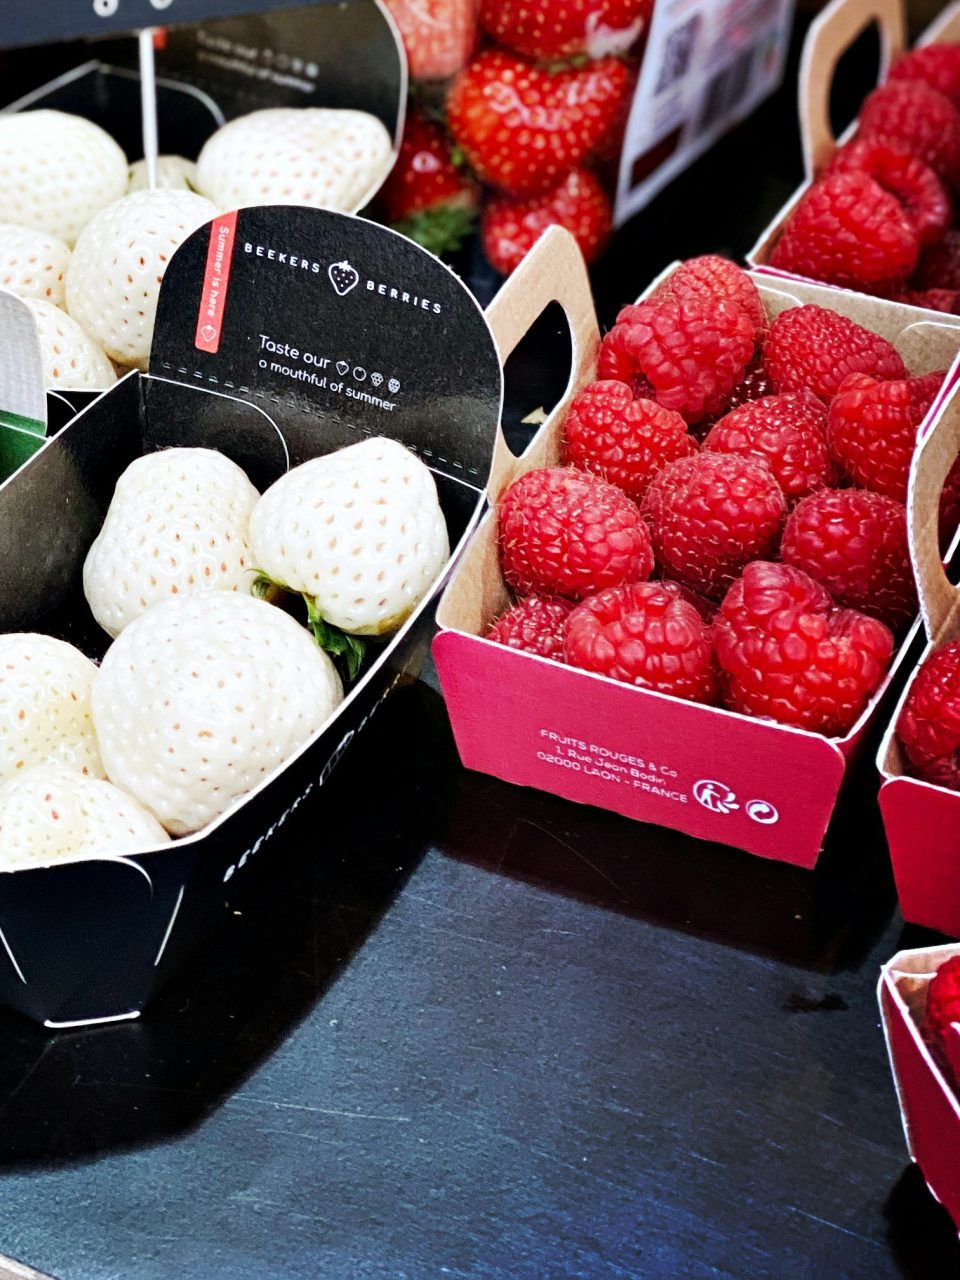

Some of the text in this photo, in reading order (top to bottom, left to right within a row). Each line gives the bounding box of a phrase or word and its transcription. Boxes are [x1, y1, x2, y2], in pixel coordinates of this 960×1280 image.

[207, 225, 229, 317] Summer is here
[244, 243, 442, 314] BEEKERS BERRIES
[259, 334, 331, 369] Taste our
[270, 362, 326, 389] mouthful
[329, 382, 344, 393] of
[345, 387, 397, 411] summer
[540, 729, 587, 750] FRUITS
[590, 744, 645, 768] ROUGES
[648, 762, 657, 771] &
[568, 749, 592, 763] Rue
[595, 758, 628, 773] Jean
[537, 751, 581, 770] 02000
[583, 765, 621, 783] LAON
[633, 780, 688, 803] FRANCE
